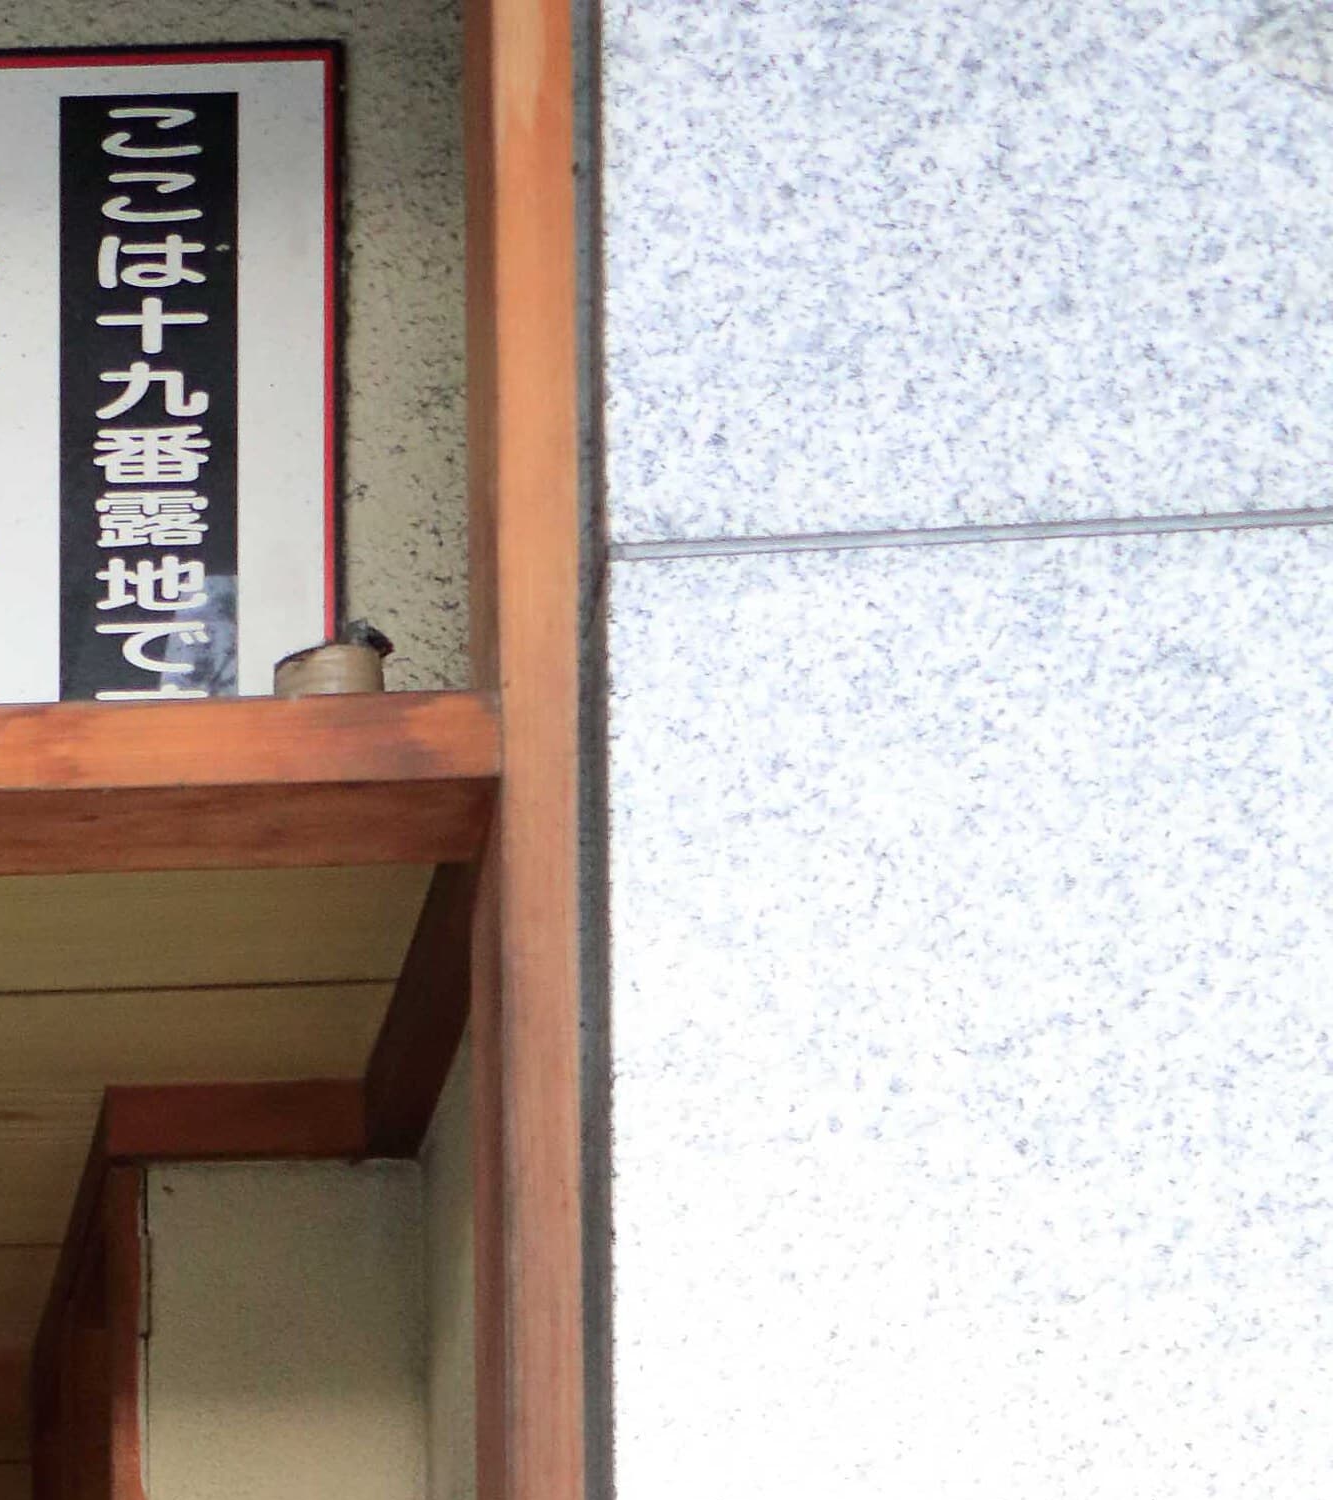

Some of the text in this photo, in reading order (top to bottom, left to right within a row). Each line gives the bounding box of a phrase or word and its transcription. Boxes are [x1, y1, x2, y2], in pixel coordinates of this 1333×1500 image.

[93, 105, 213, 701] ここは十九番露地で
